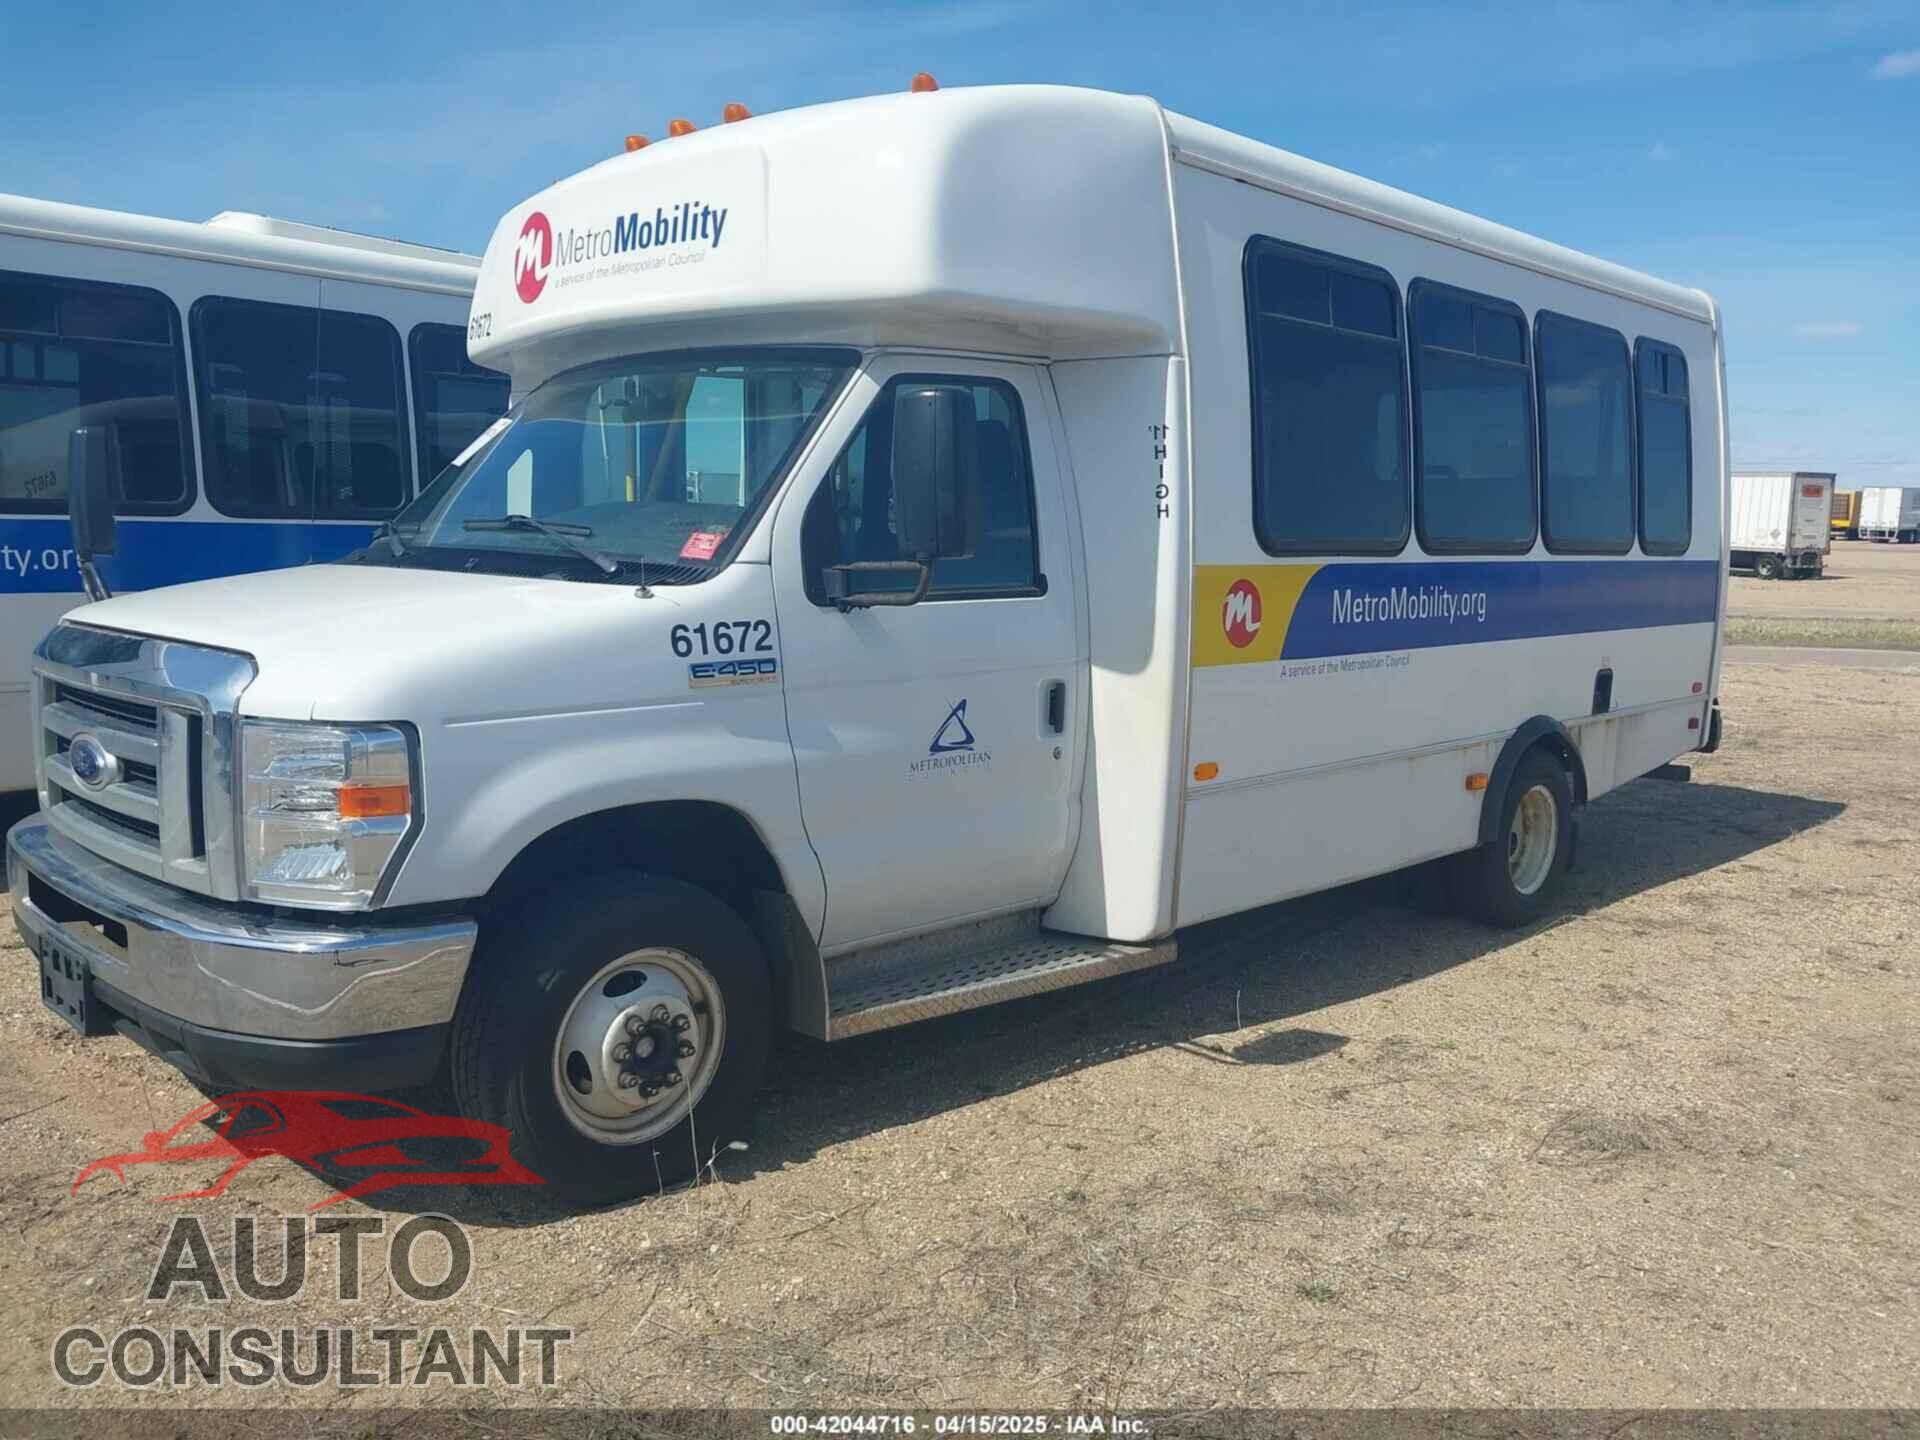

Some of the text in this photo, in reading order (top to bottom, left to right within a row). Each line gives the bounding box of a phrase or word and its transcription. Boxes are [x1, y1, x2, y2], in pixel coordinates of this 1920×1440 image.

[555, 201, 727, 267] MetroMobility
[611, 256, 666, 275] Metropolitan
[668, 249, 705, 267] Council
[469, 312, 491, 341] 61672
[1332, 586, 1487, 625] MetroMobility.org
[670, 619, 773, 658] 61672
[692, 660, 776, 679] E-450
[1288, 664, 1316, 678] service
[1318, 661, 1326, 675] of
[1327, 660, 1339, 673] the
[1340, 656, 1384, 672] Metropolitan
[1385, 653, 1410, 668] Council
[910, 752, 992, 772] METROPOLITAN
